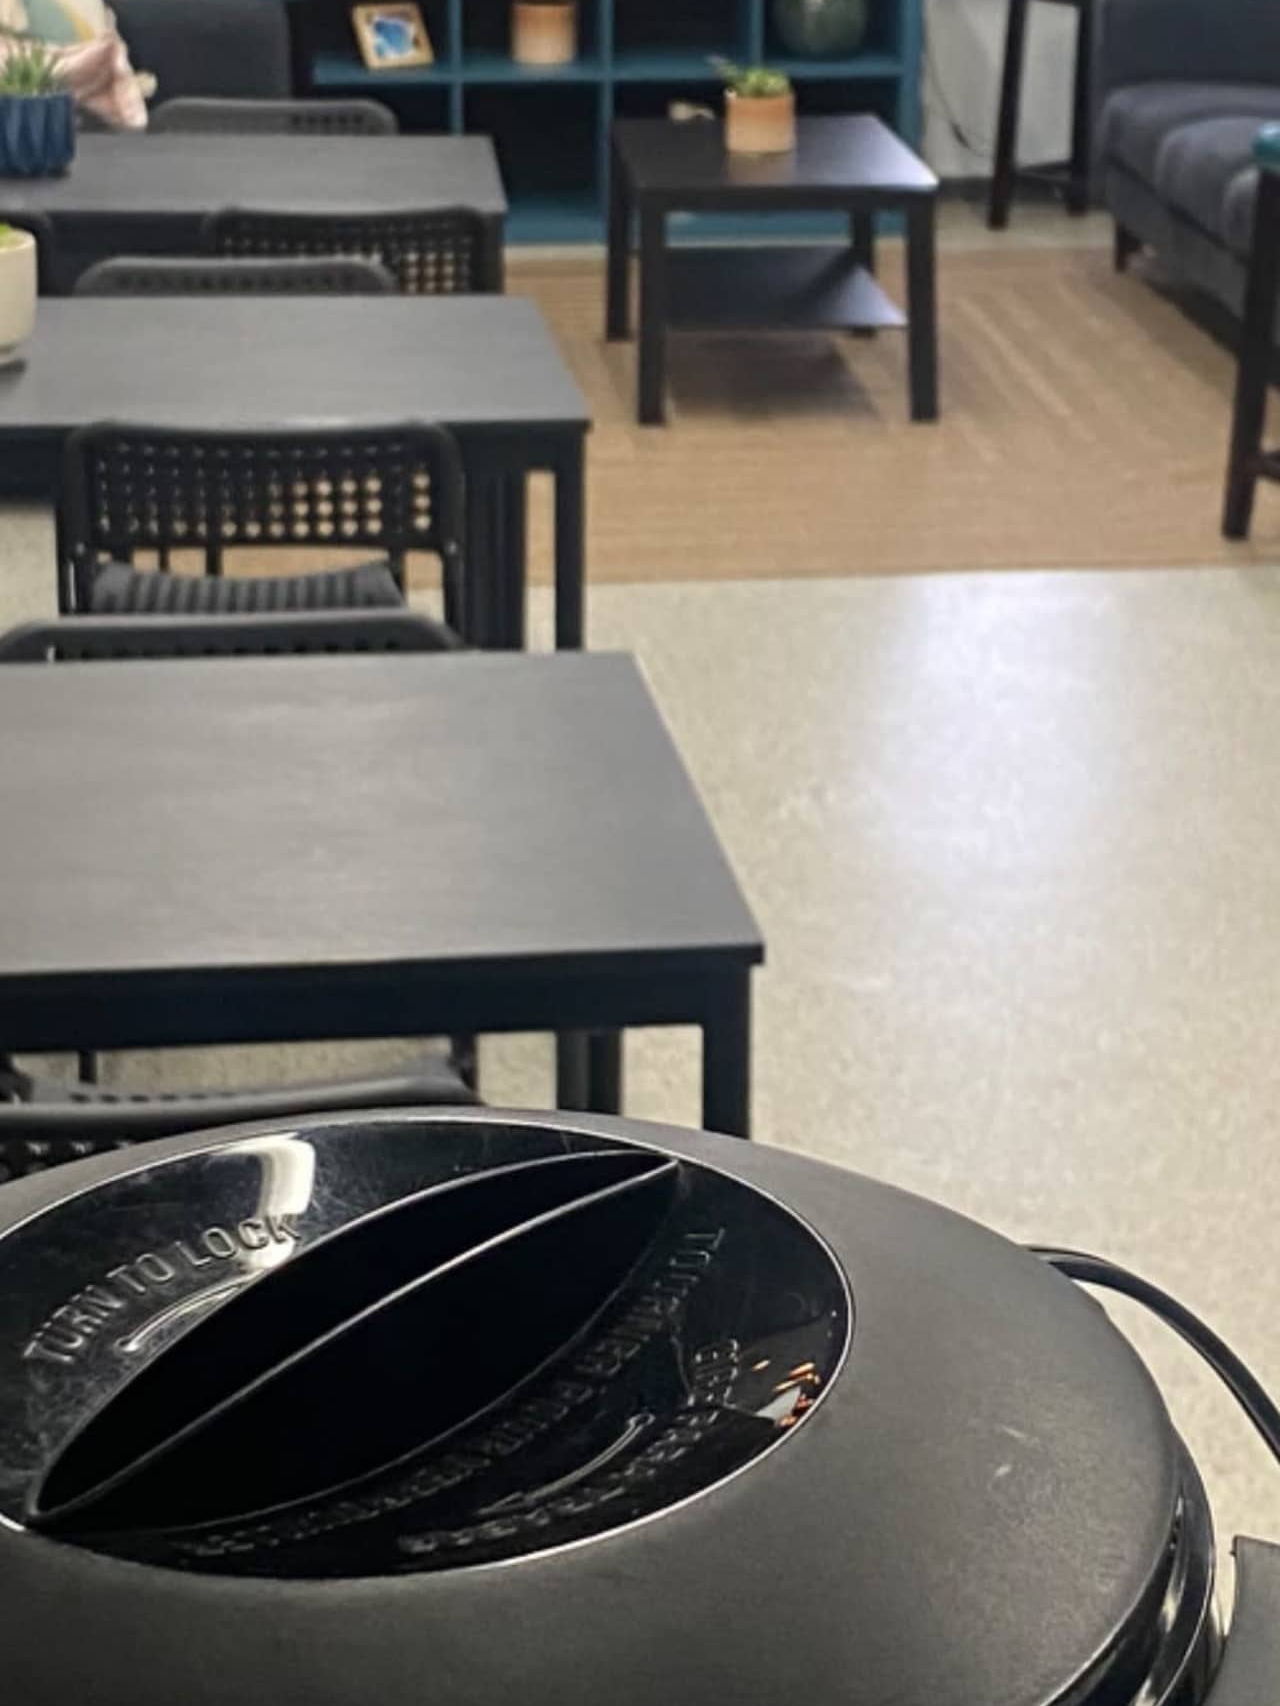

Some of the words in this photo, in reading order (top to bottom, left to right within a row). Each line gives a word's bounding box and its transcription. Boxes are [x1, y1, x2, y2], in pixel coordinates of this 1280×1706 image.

[23, 1284, 124, 1362] TURN
[106, 1252, 175, 1293] TO
[174, 1213, 300, 1267] LOCK
